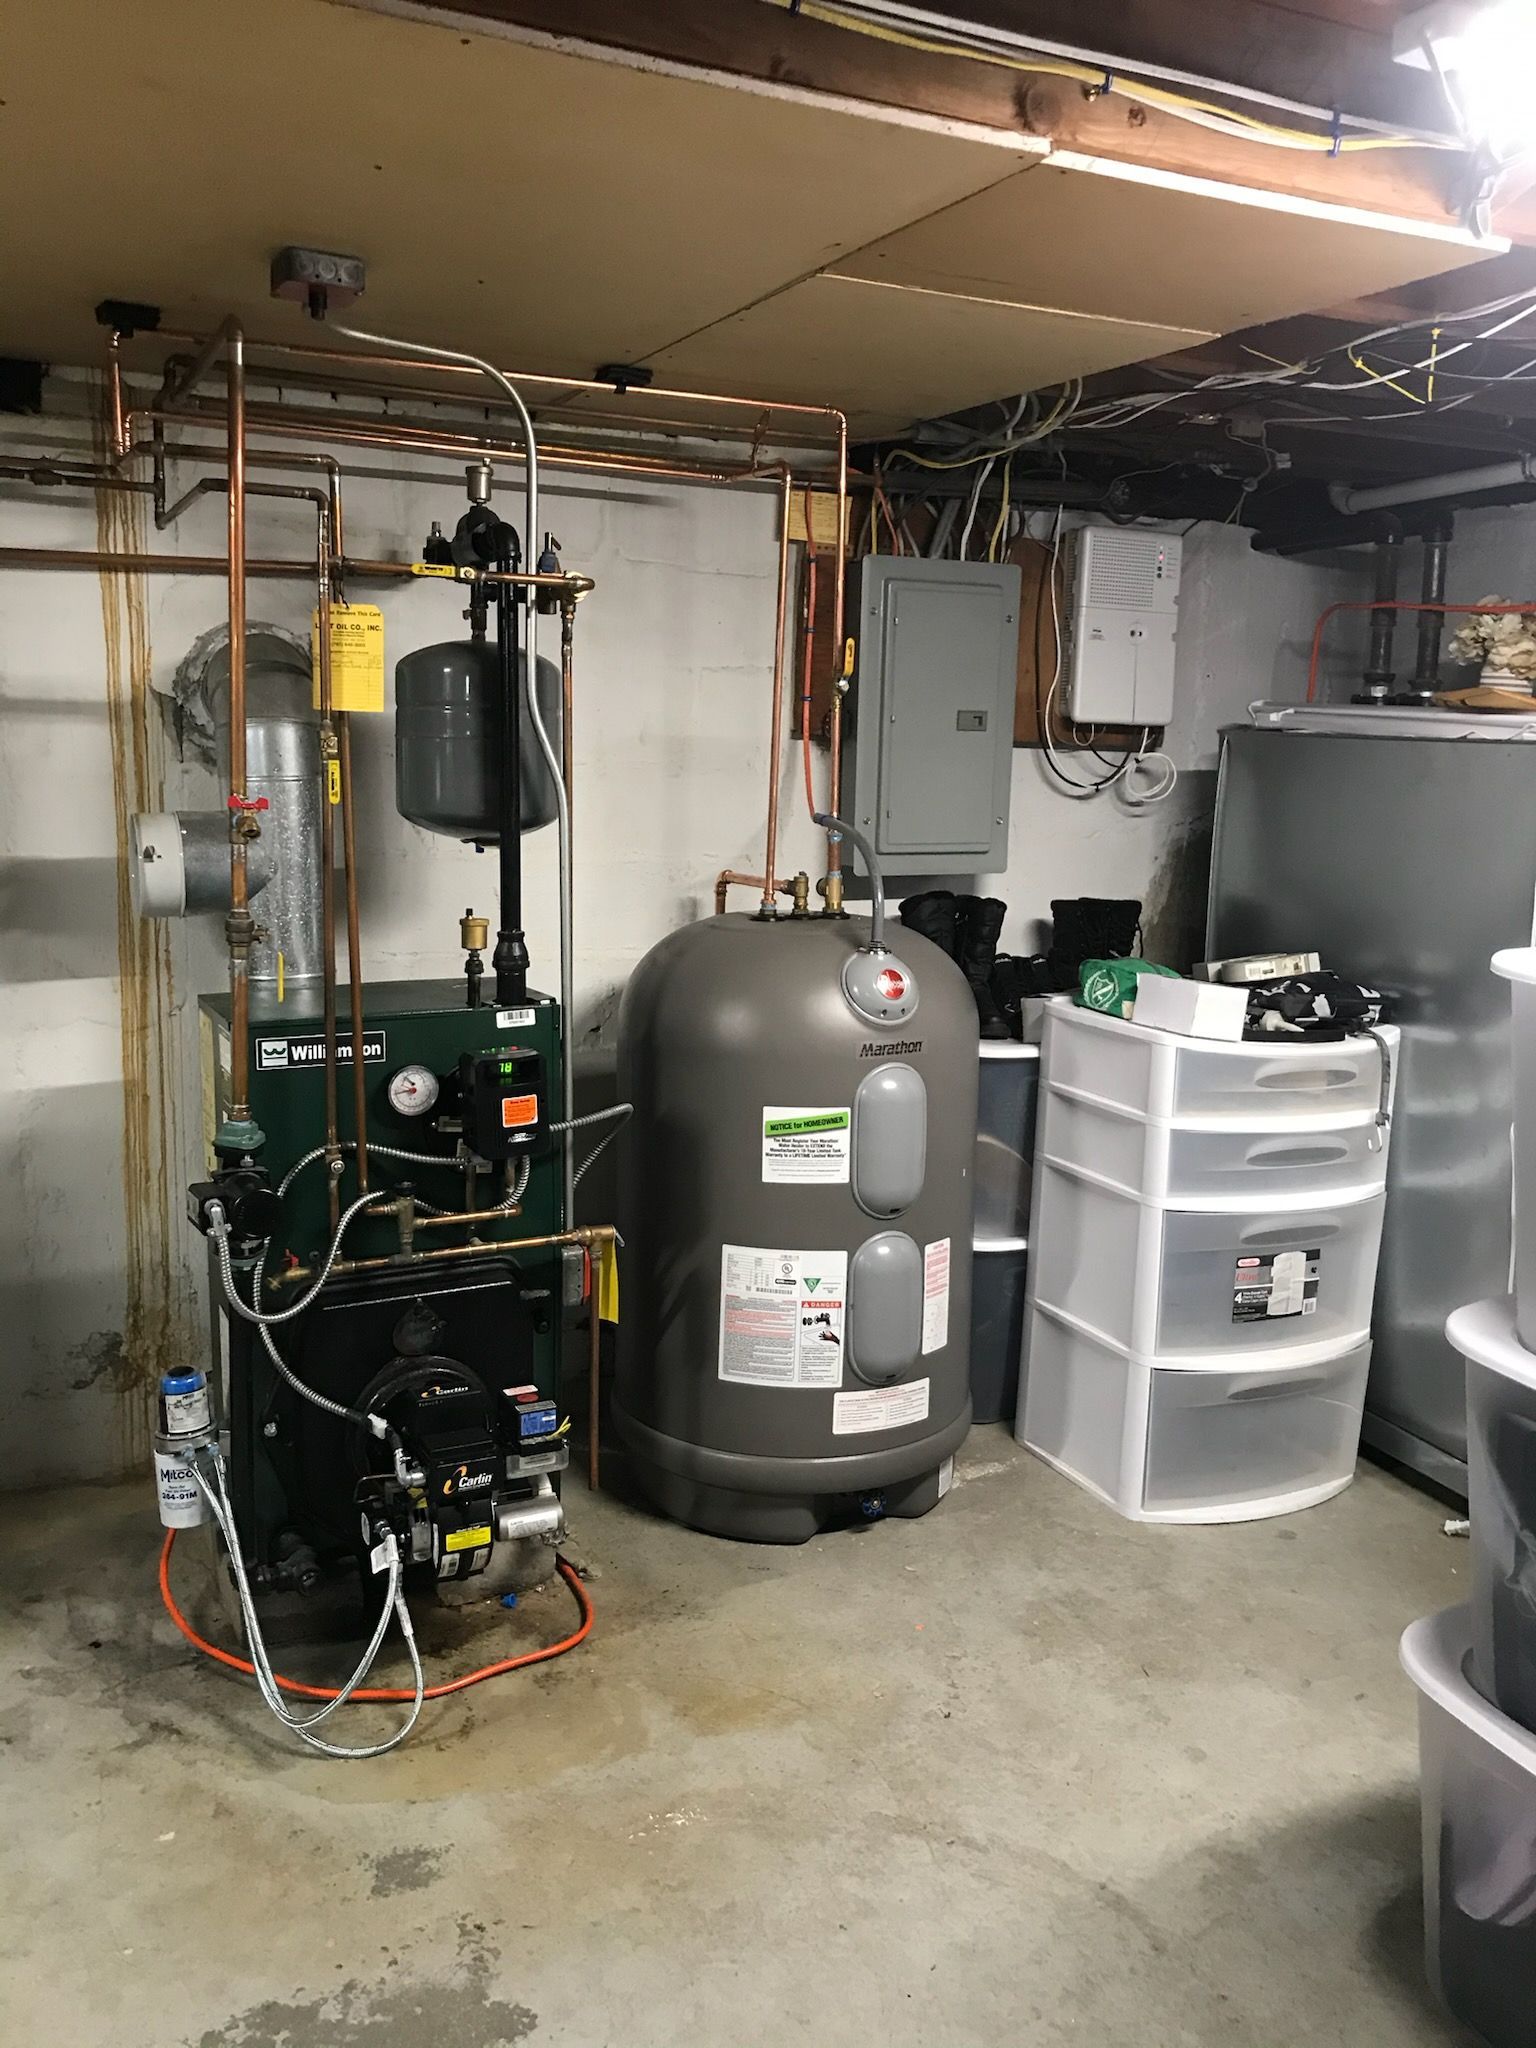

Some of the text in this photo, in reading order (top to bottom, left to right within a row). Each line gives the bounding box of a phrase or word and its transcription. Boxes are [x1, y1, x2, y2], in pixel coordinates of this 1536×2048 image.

[291, 1044, 381, 1061] Willimon
[859, 1040, 924, 1058] Marathon
[770, 1122, 793, 1131] NOTICE
[803, 1116, 844, 1128] HOMEOWNER
[1235, 1292, 1242, 1303] 4
[160, 1468, 194, 1483] Mitco
[458, 1472, 493, 1488] Carlin
